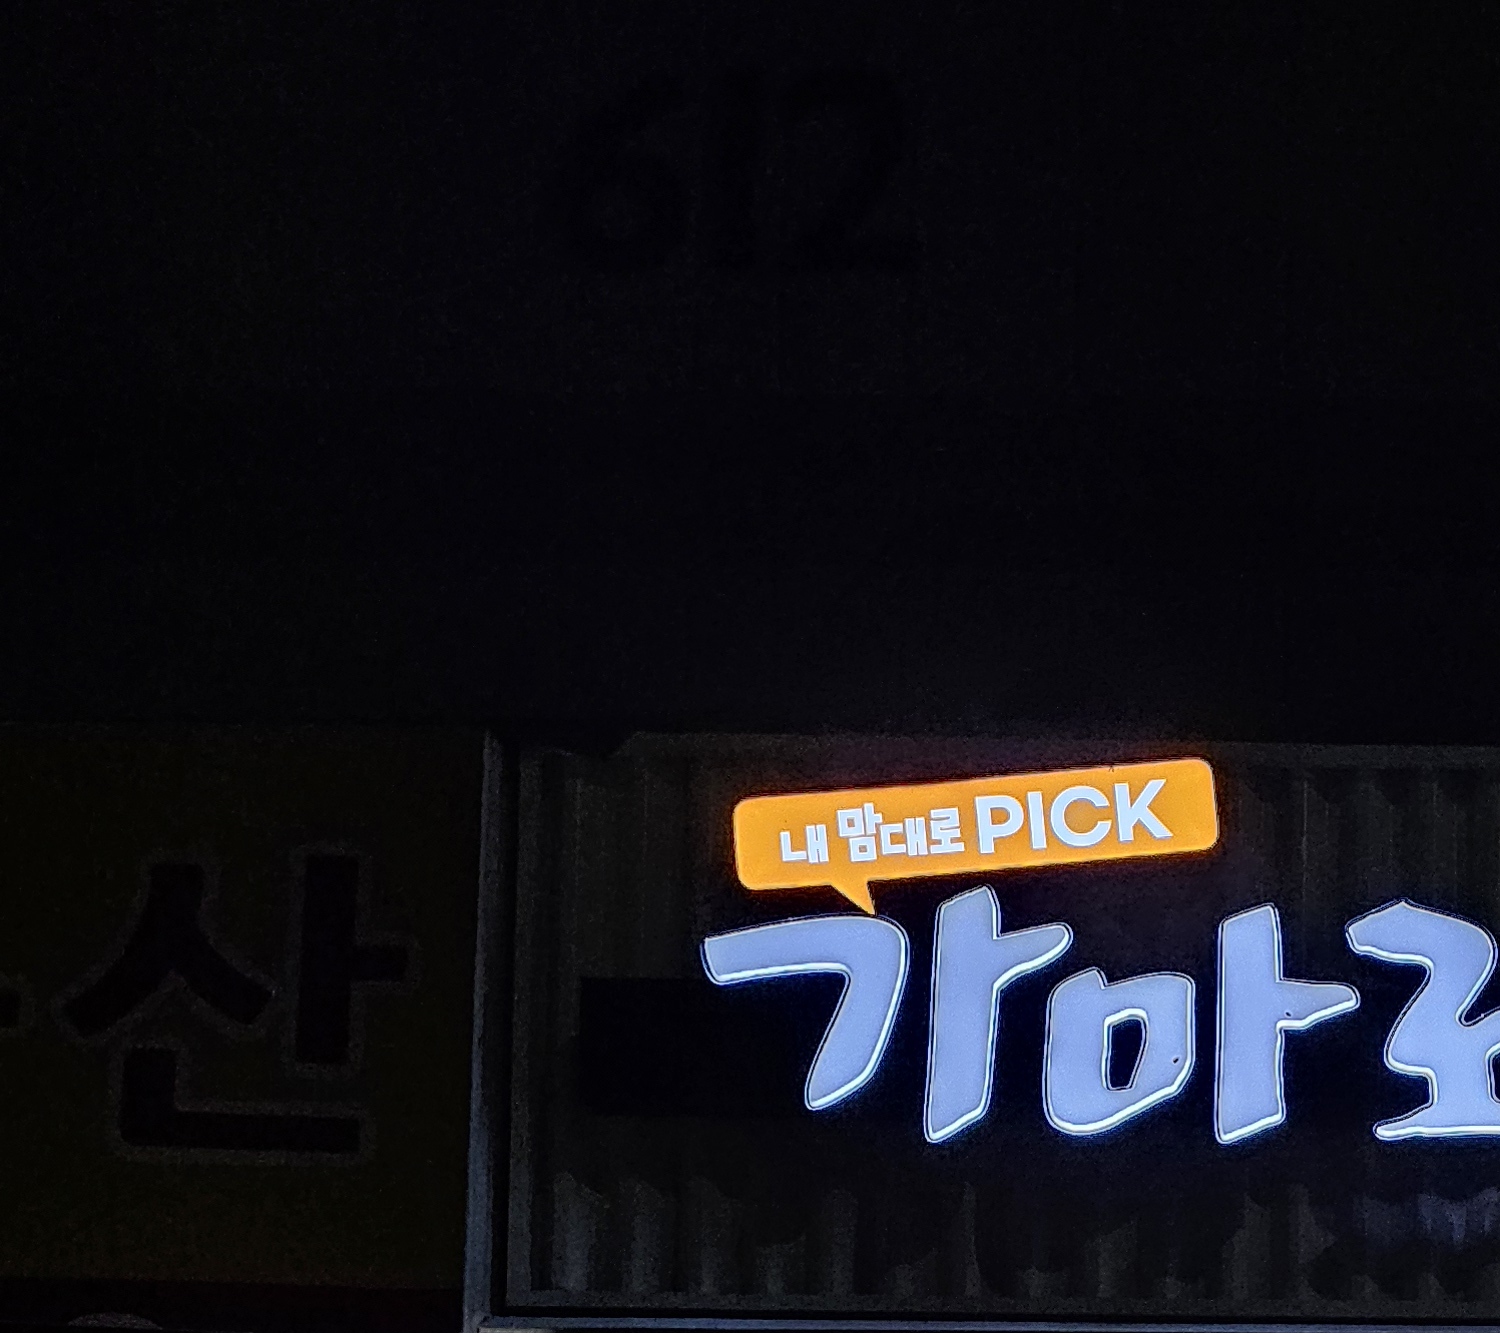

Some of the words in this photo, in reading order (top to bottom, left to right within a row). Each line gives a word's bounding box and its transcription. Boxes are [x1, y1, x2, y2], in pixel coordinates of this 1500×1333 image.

[779, 823, 830, 863] 내
[836, 802, 966, 863] 맘대로
[974, 778, 1175, 855] PICK
